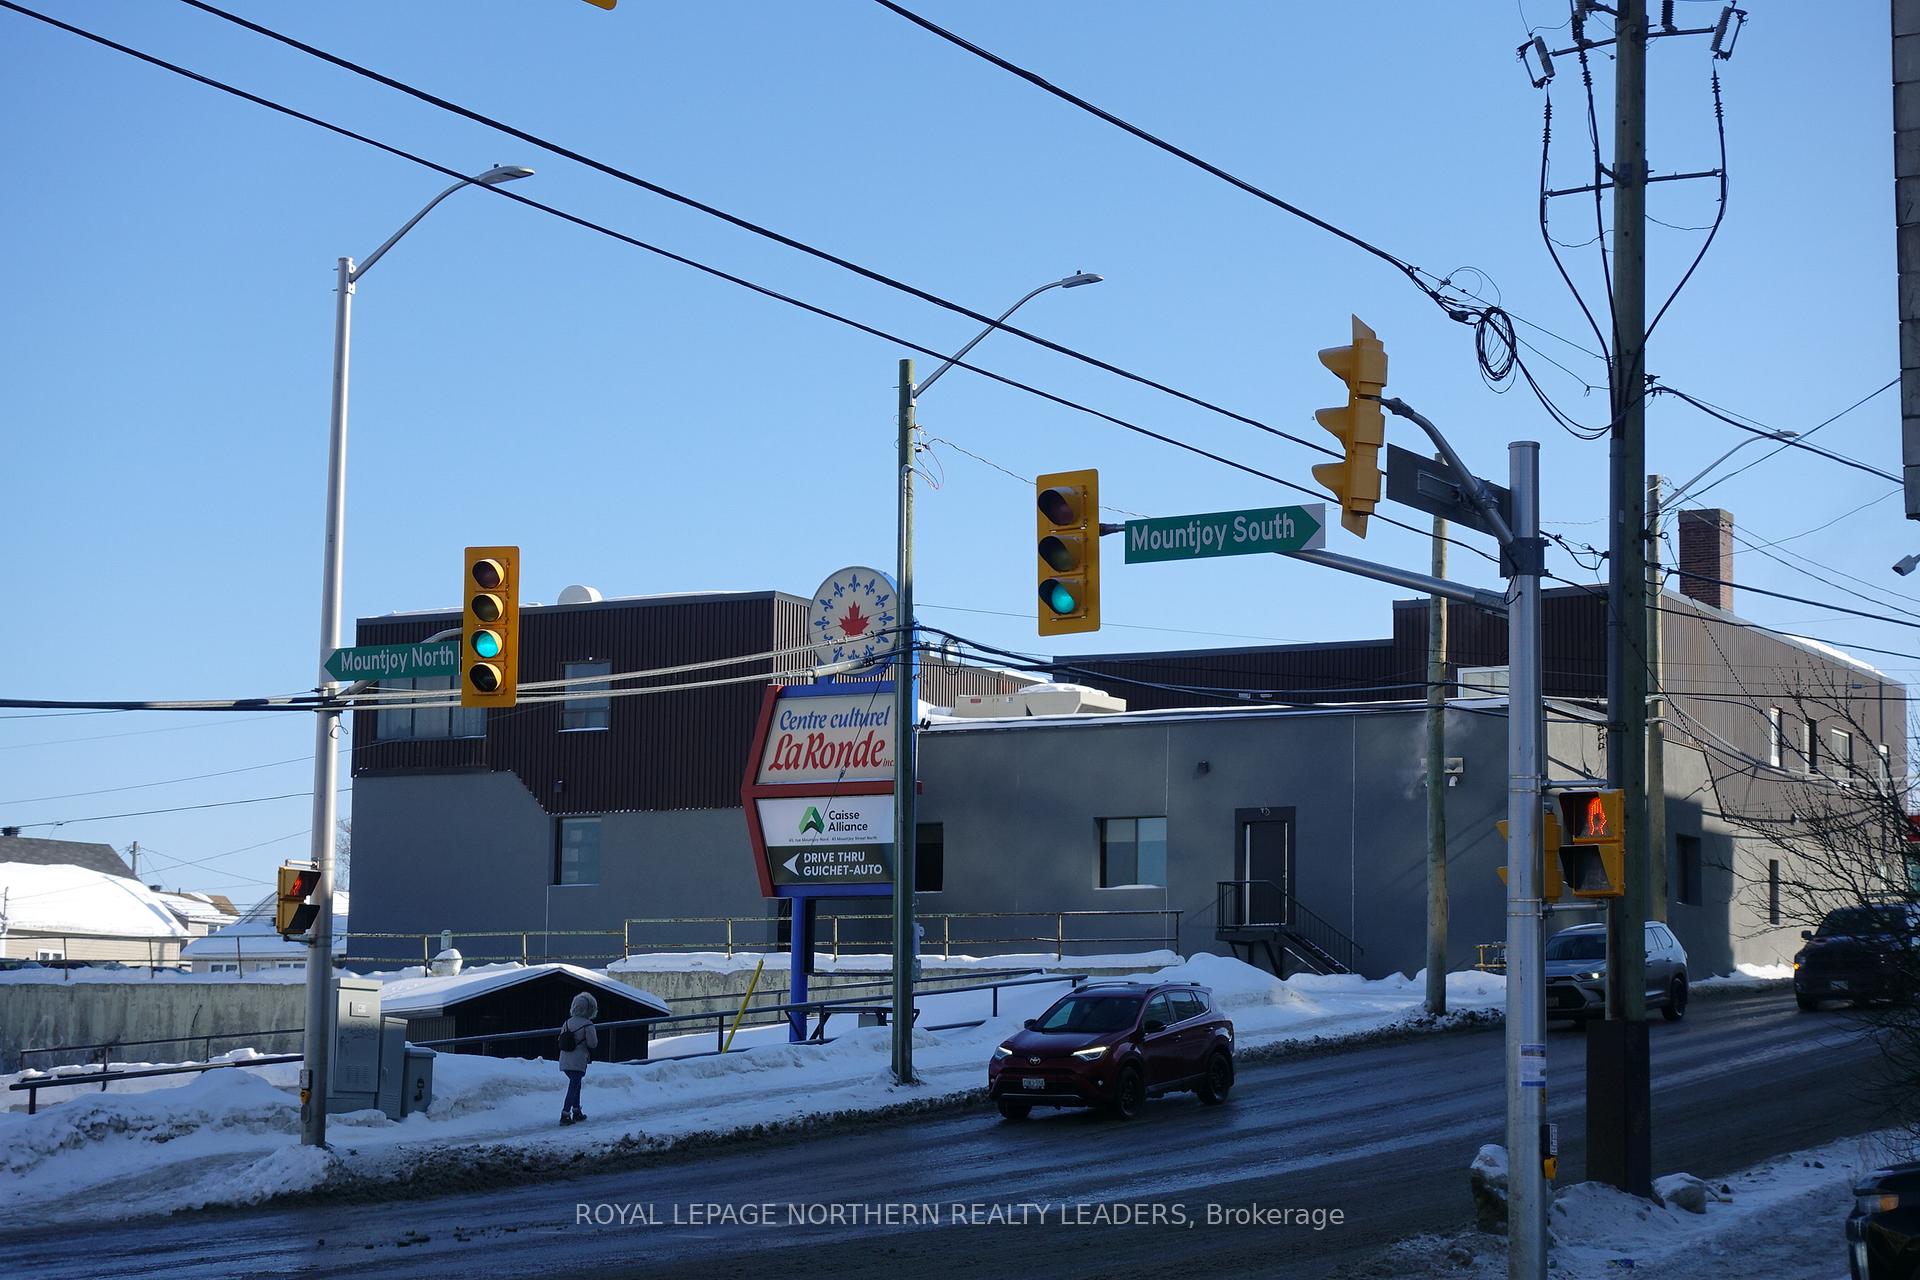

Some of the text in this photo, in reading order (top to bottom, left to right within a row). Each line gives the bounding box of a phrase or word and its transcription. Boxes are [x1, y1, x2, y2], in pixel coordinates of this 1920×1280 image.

[1131, 512, 1295, 554] Mountjoy South
[341, 645, 454, 675] Mountjoy North
[780, 705, 891, 731] Centre culturel
[828, 810, 860, 821] Caisse
[828, 821, 868, 832] Alliance
[803, 851, 865, 863] DRIVE THRU
[803, 864, 883, 876] GUICHET-AUTO
